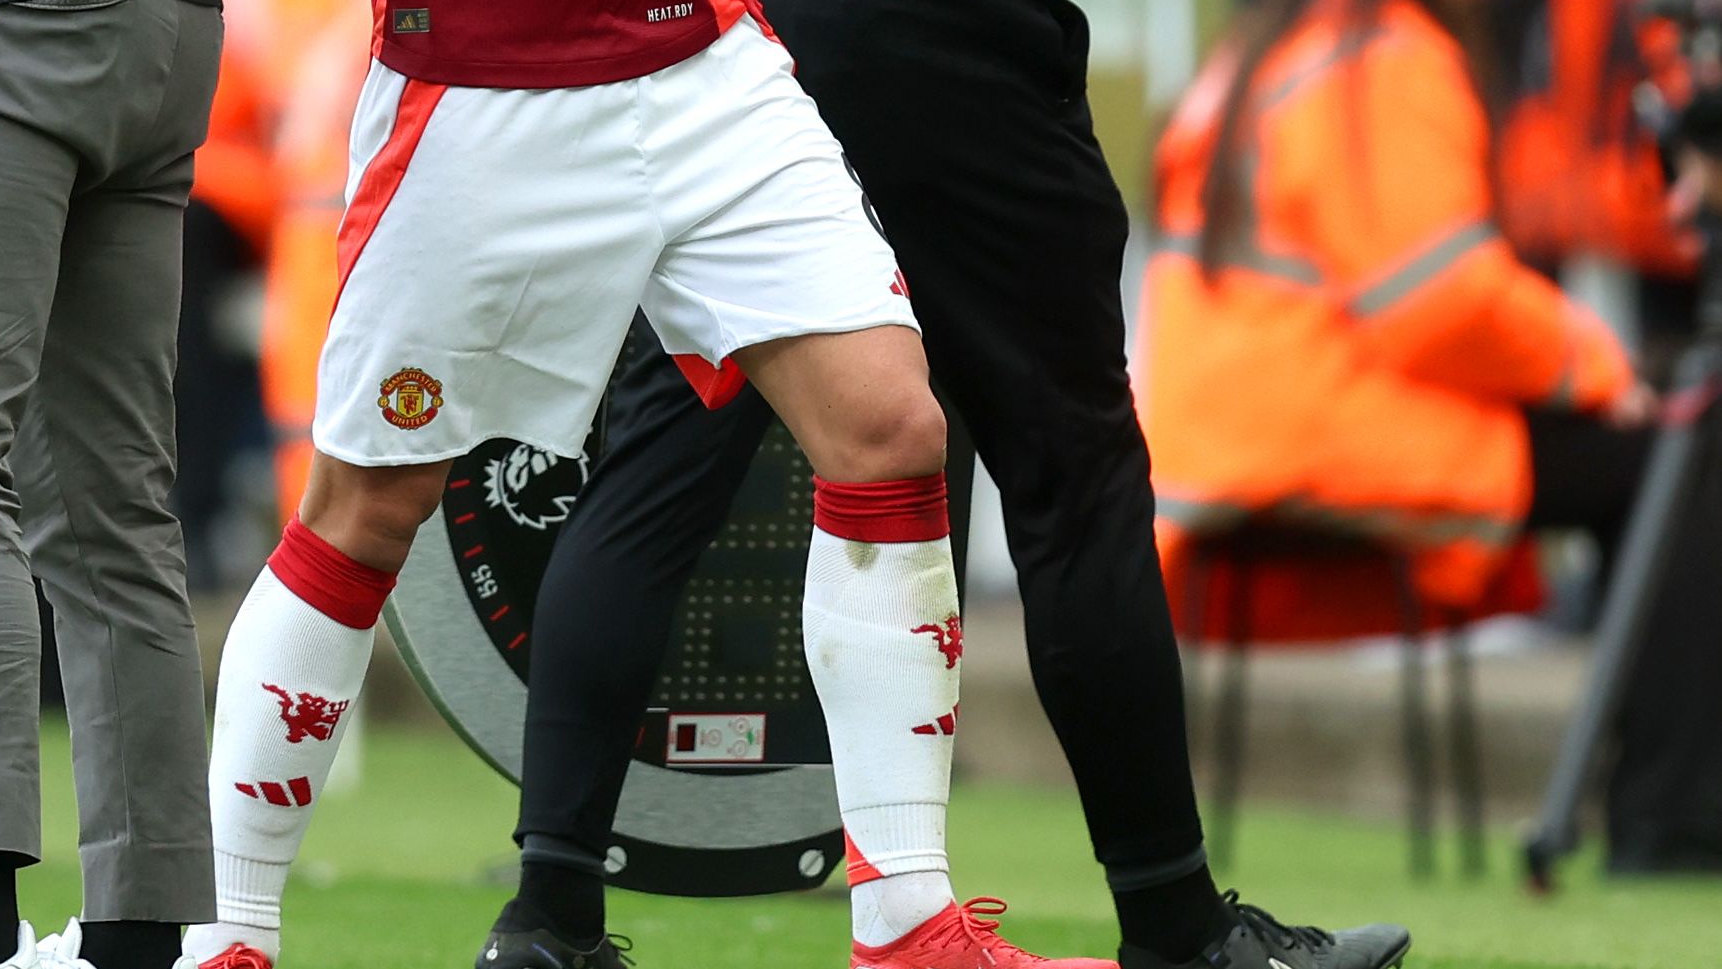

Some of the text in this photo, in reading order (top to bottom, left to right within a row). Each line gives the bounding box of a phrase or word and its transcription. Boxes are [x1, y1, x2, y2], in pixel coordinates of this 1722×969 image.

[647, 2, 693, 23] HEAT.RDY
[385, 372, 438, 392] MANCHESTER
[392, 414, 428, 426] UNITED
[471, 564, 498, 599] 55
